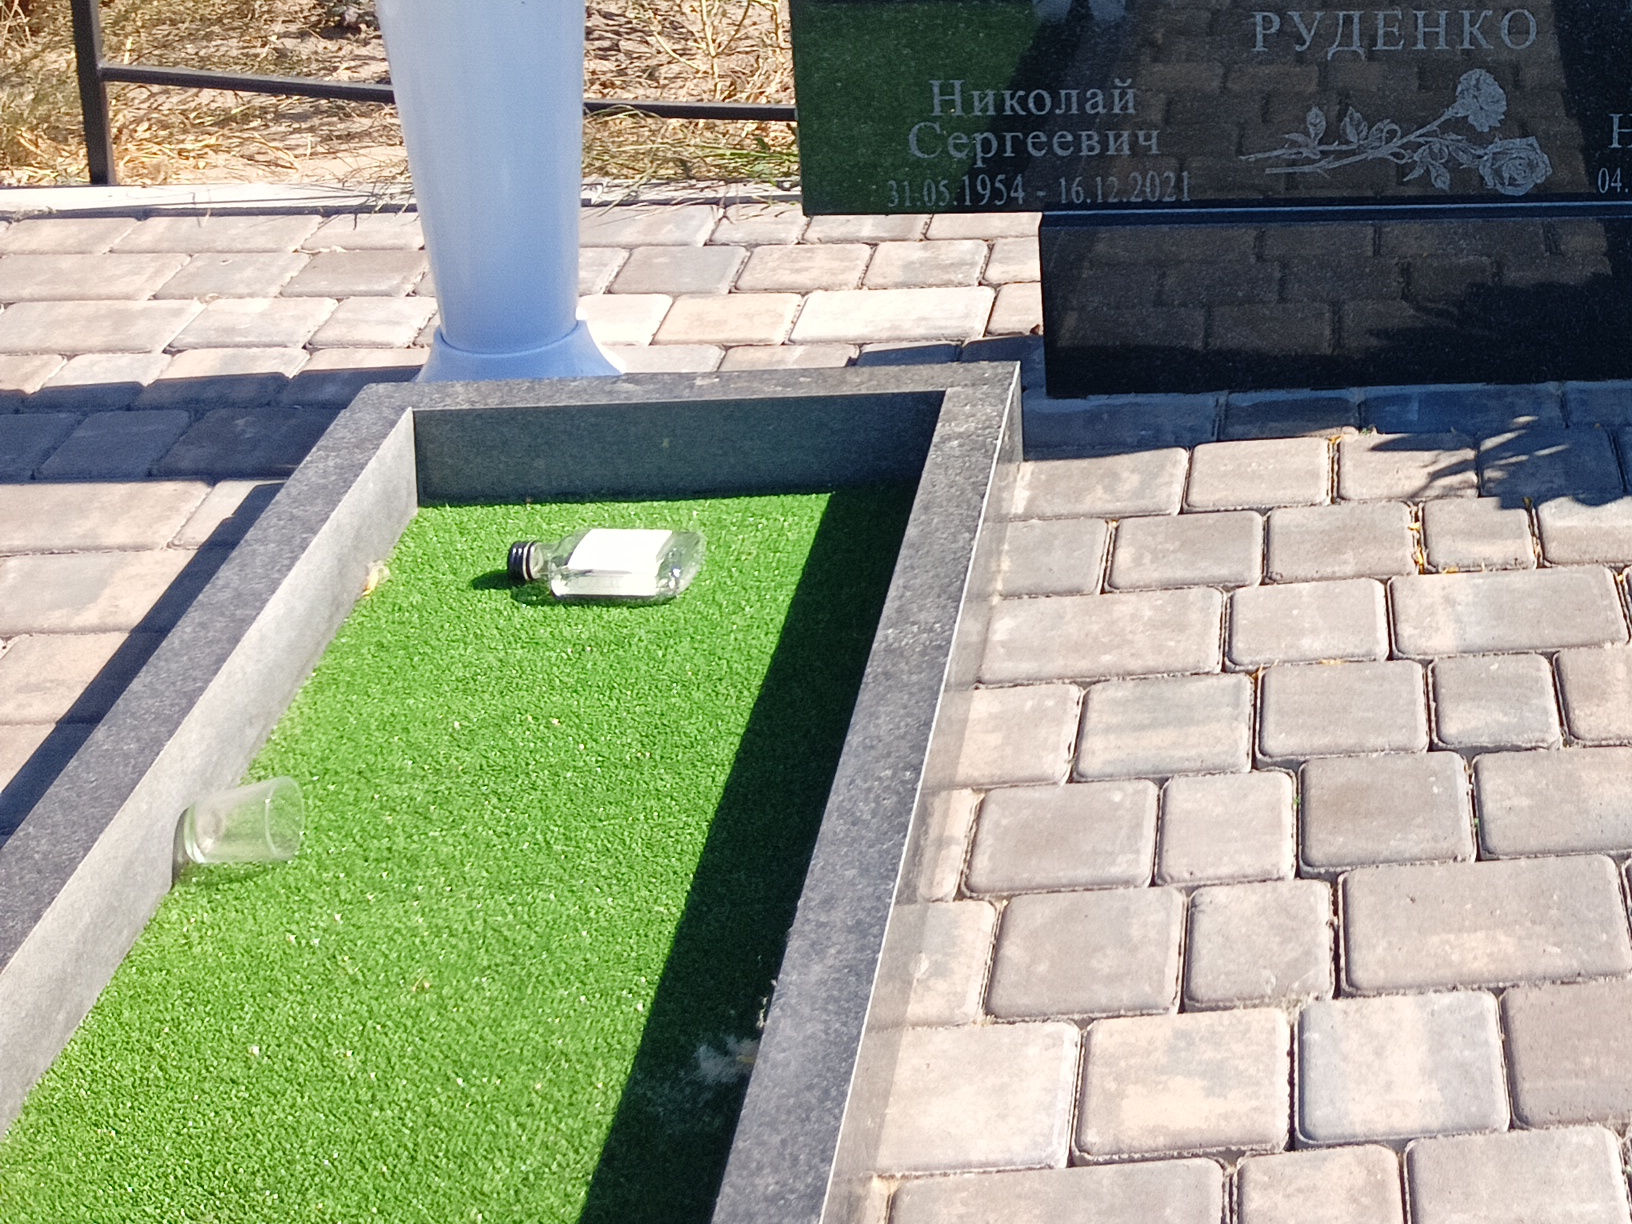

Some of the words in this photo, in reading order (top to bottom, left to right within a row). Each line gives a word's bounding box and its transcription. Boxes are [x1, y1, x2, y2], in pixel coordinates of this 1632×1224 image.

[1251, 9, 1538, 61] РУДЕНКО
[928, 78, 1137, 116] Николай
[908, 121, 1162, 168] Сергеевич
[887, 173, 1025, 208] 31.05.1954
[1058, 171, 1191, 205] 16.12.2021
